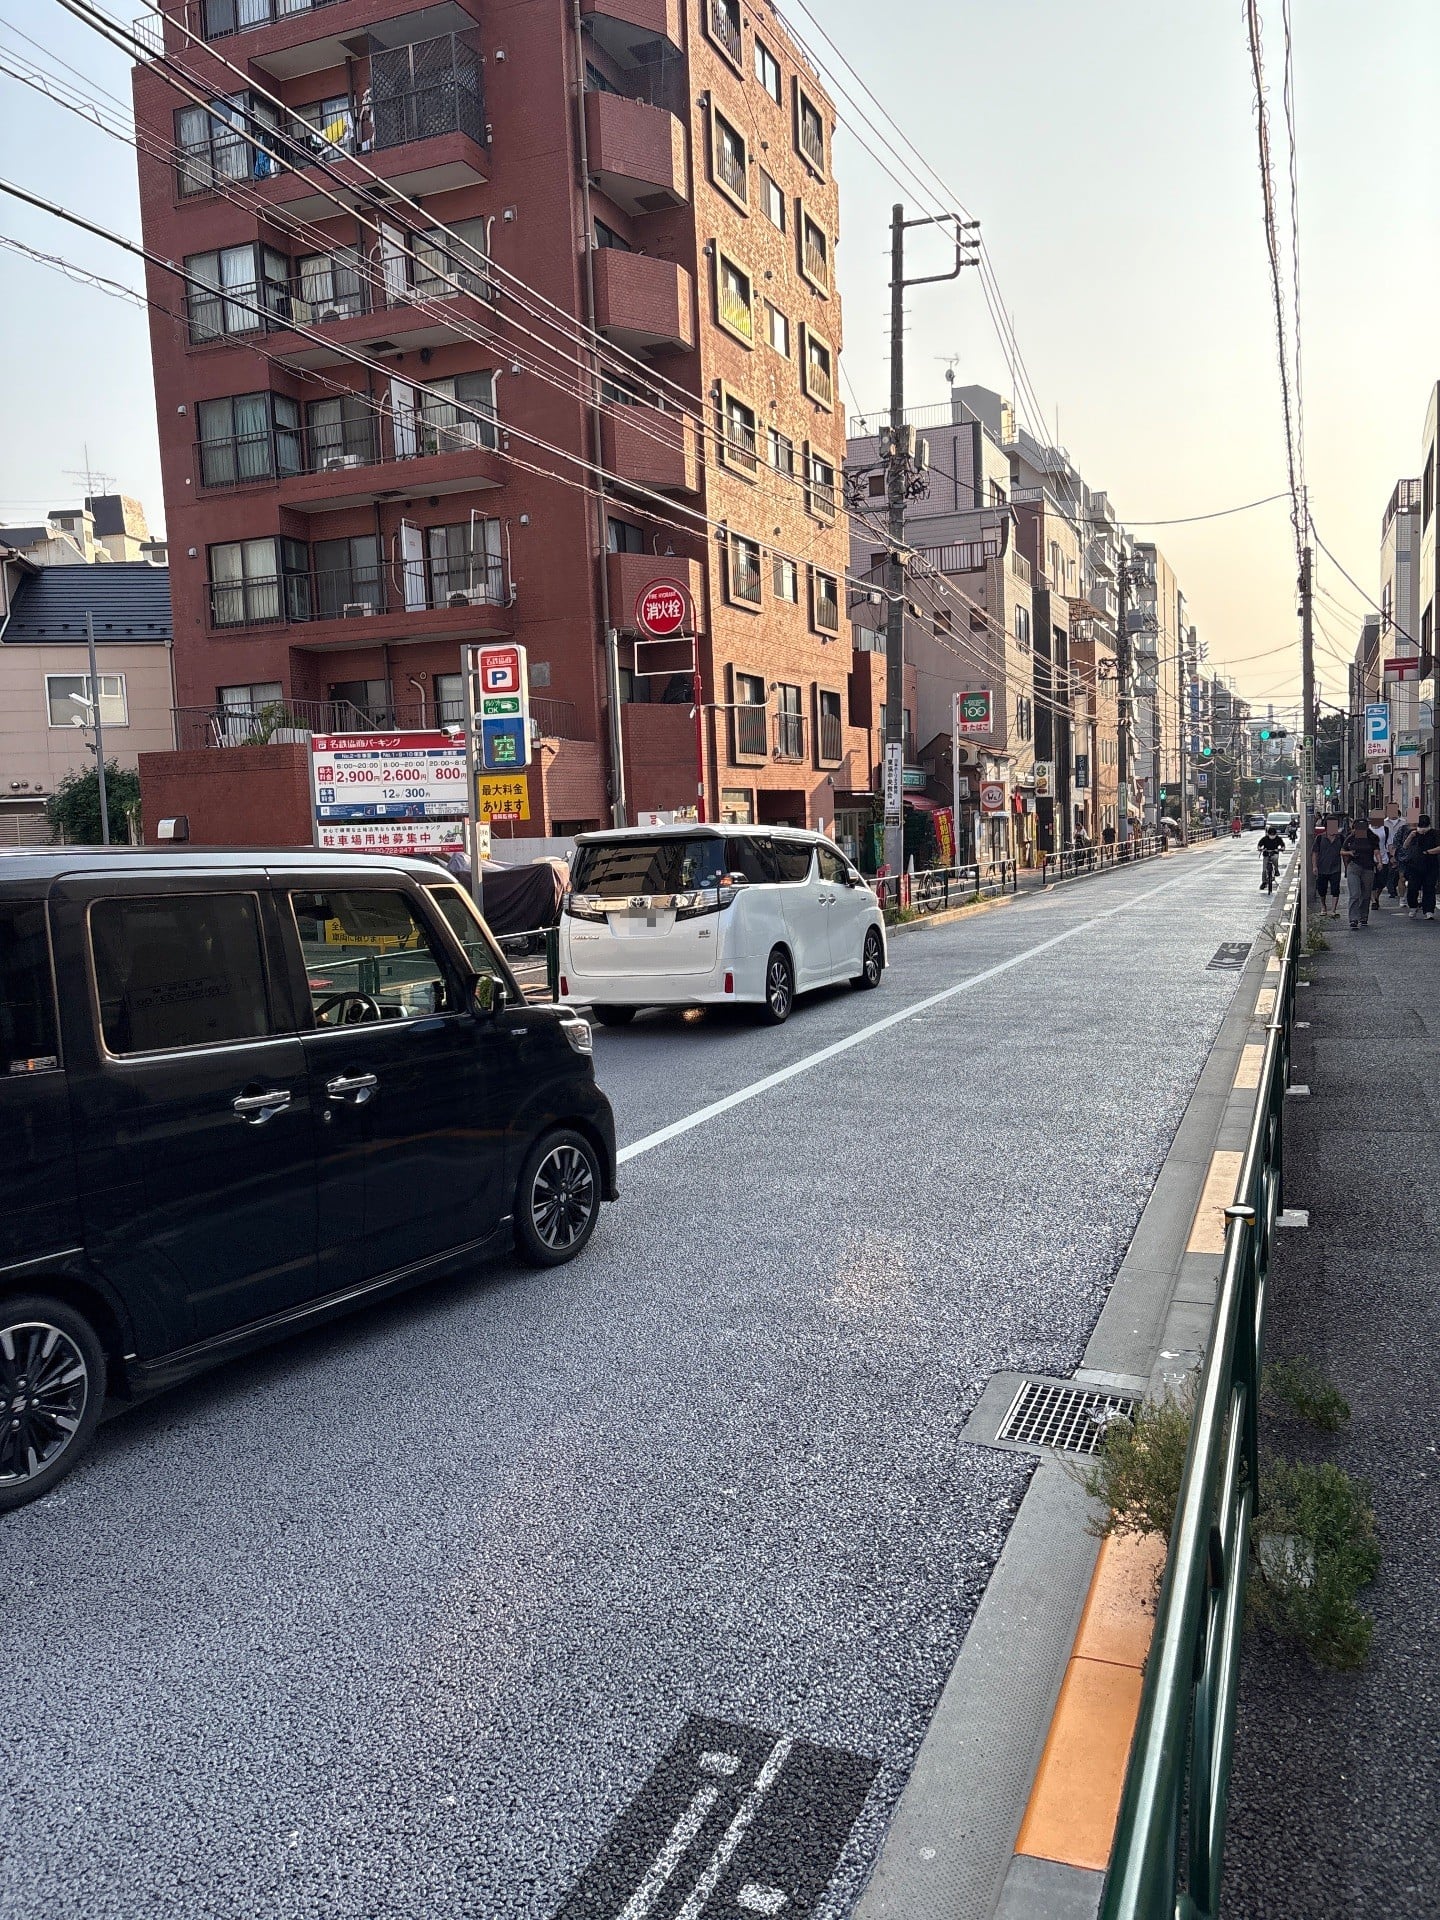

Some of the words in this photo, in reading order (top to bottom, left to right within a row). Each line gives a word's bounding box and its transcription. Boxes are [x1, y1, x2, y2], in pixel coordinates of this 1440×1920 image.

[646, 599, 681, 621] 消火栓
[492, 670, 507, 685] P
[1367, 717, 1387, 740] P
[482, 783, 524, 796] 最大料金
[483, 799, 524, 813] あります
[323, 832, 431, 846] 駐車場用地募集中
